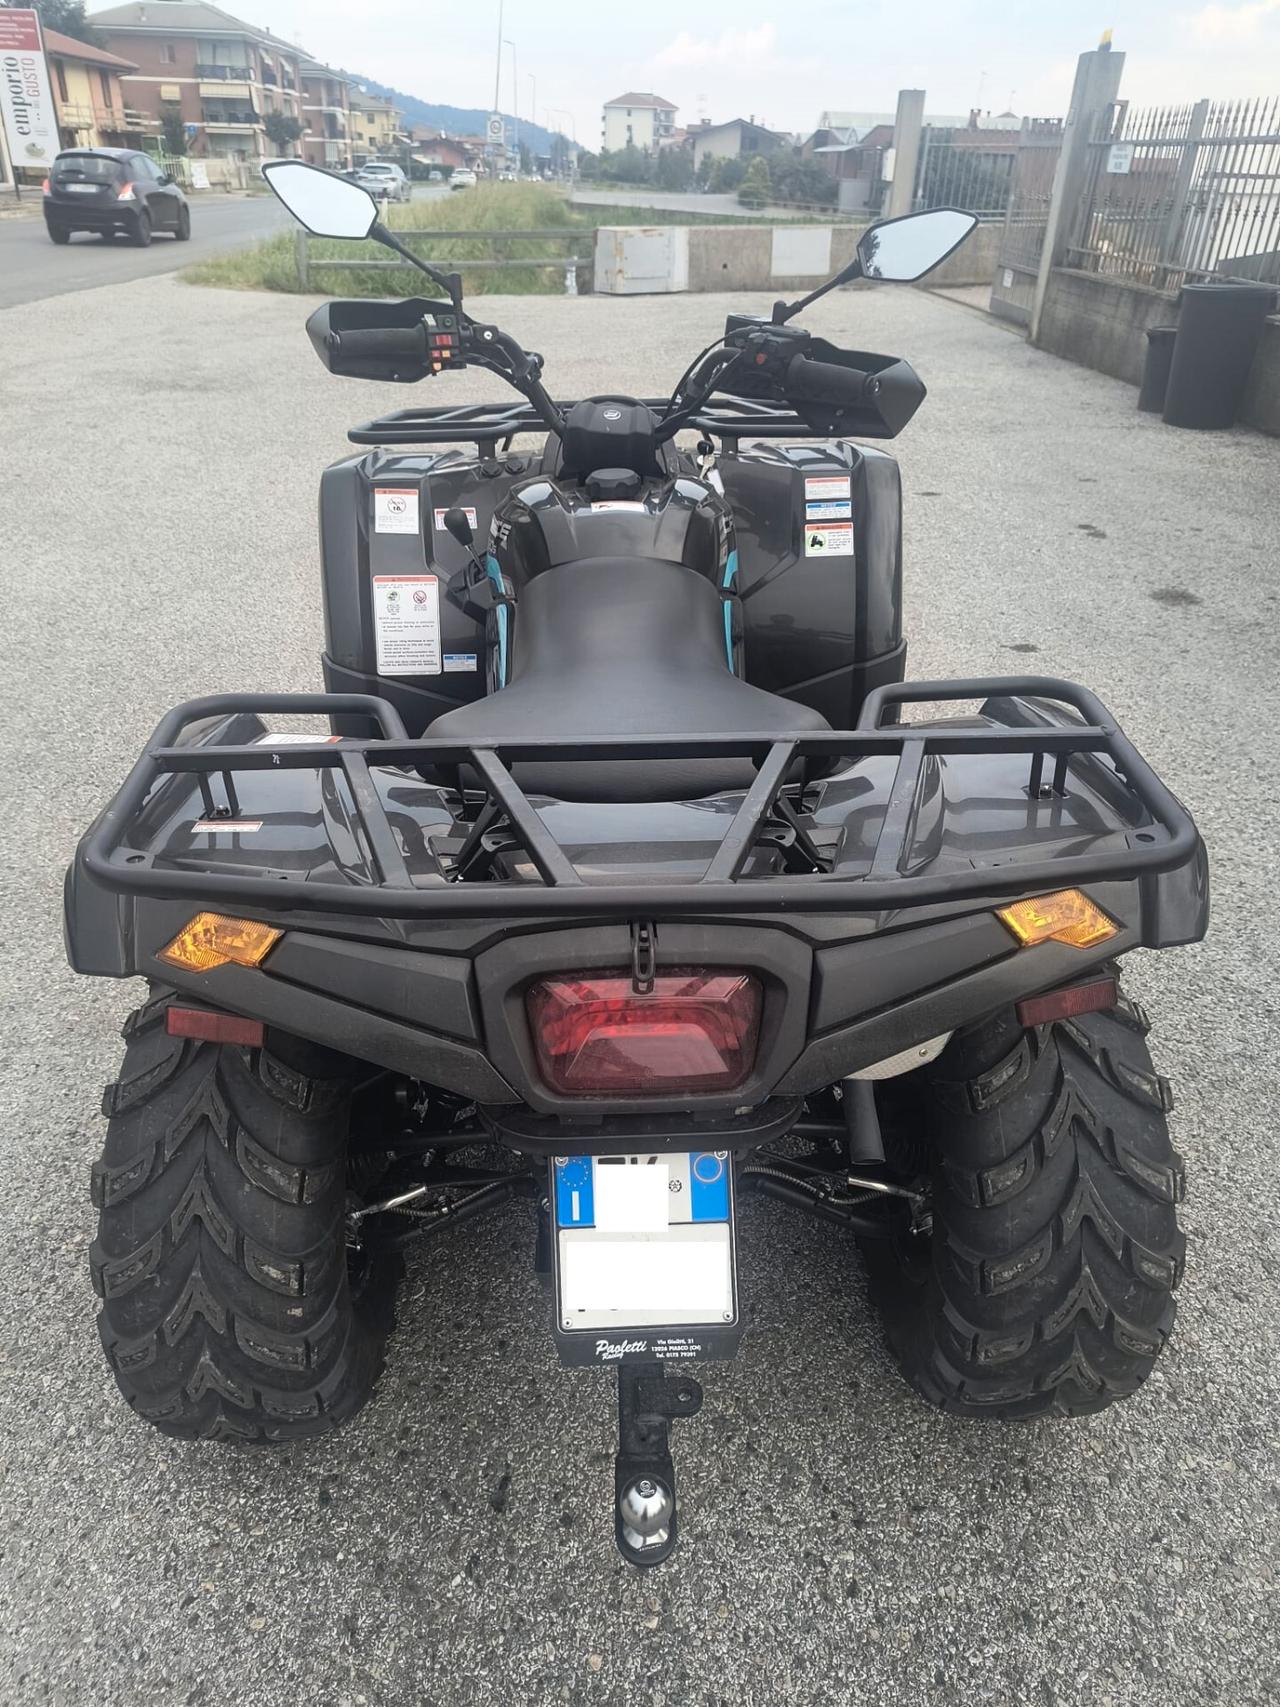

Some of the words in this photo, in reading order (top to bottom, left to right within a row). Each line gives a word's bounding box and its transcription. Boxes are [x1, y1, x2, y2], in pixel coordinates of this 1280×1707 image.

[2, 56, 32, 136] emporio
[20, 57, 41, 98] GUSTO
[595, 1339, 648, 1355] Paoletti
